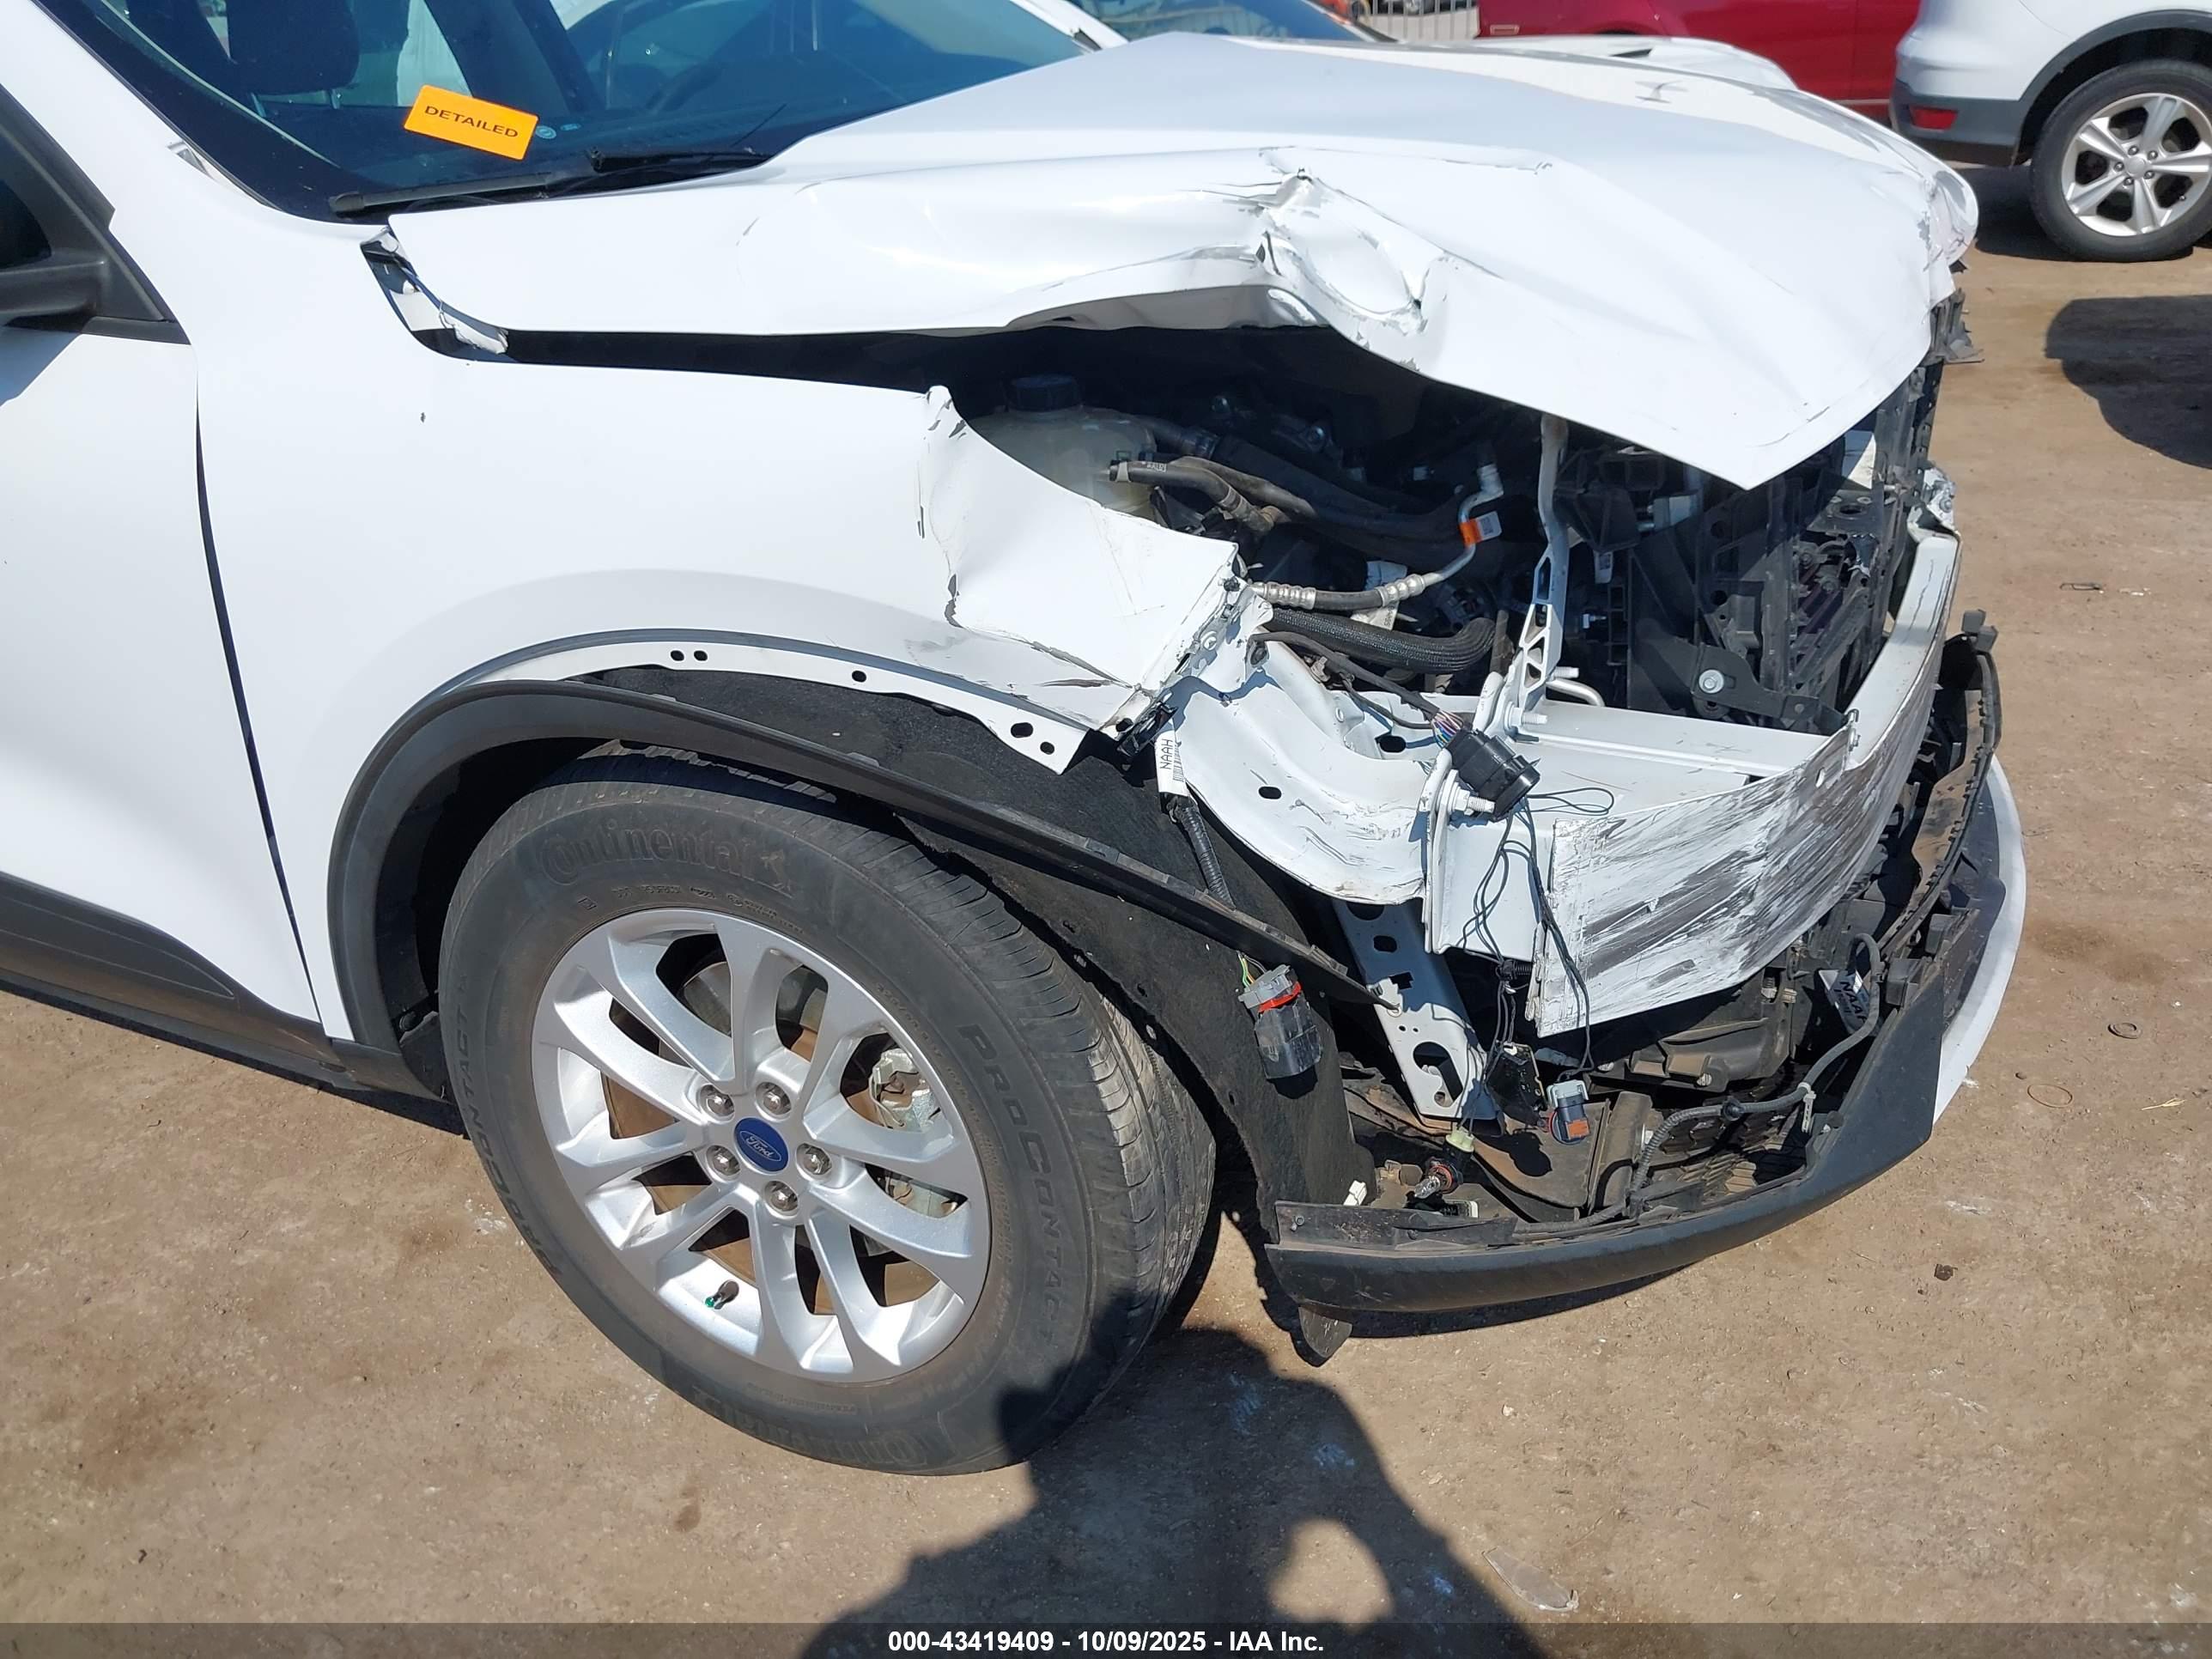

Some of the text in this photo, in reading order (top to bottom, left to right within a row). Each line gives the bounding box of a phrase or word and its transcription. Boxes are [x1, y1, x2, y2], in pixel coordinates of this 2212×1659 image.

[424, 106, 519, 137] DETAILED
[1159, 738, 1174, 769] NAAH
[539, 818, 753, 885] Continental
